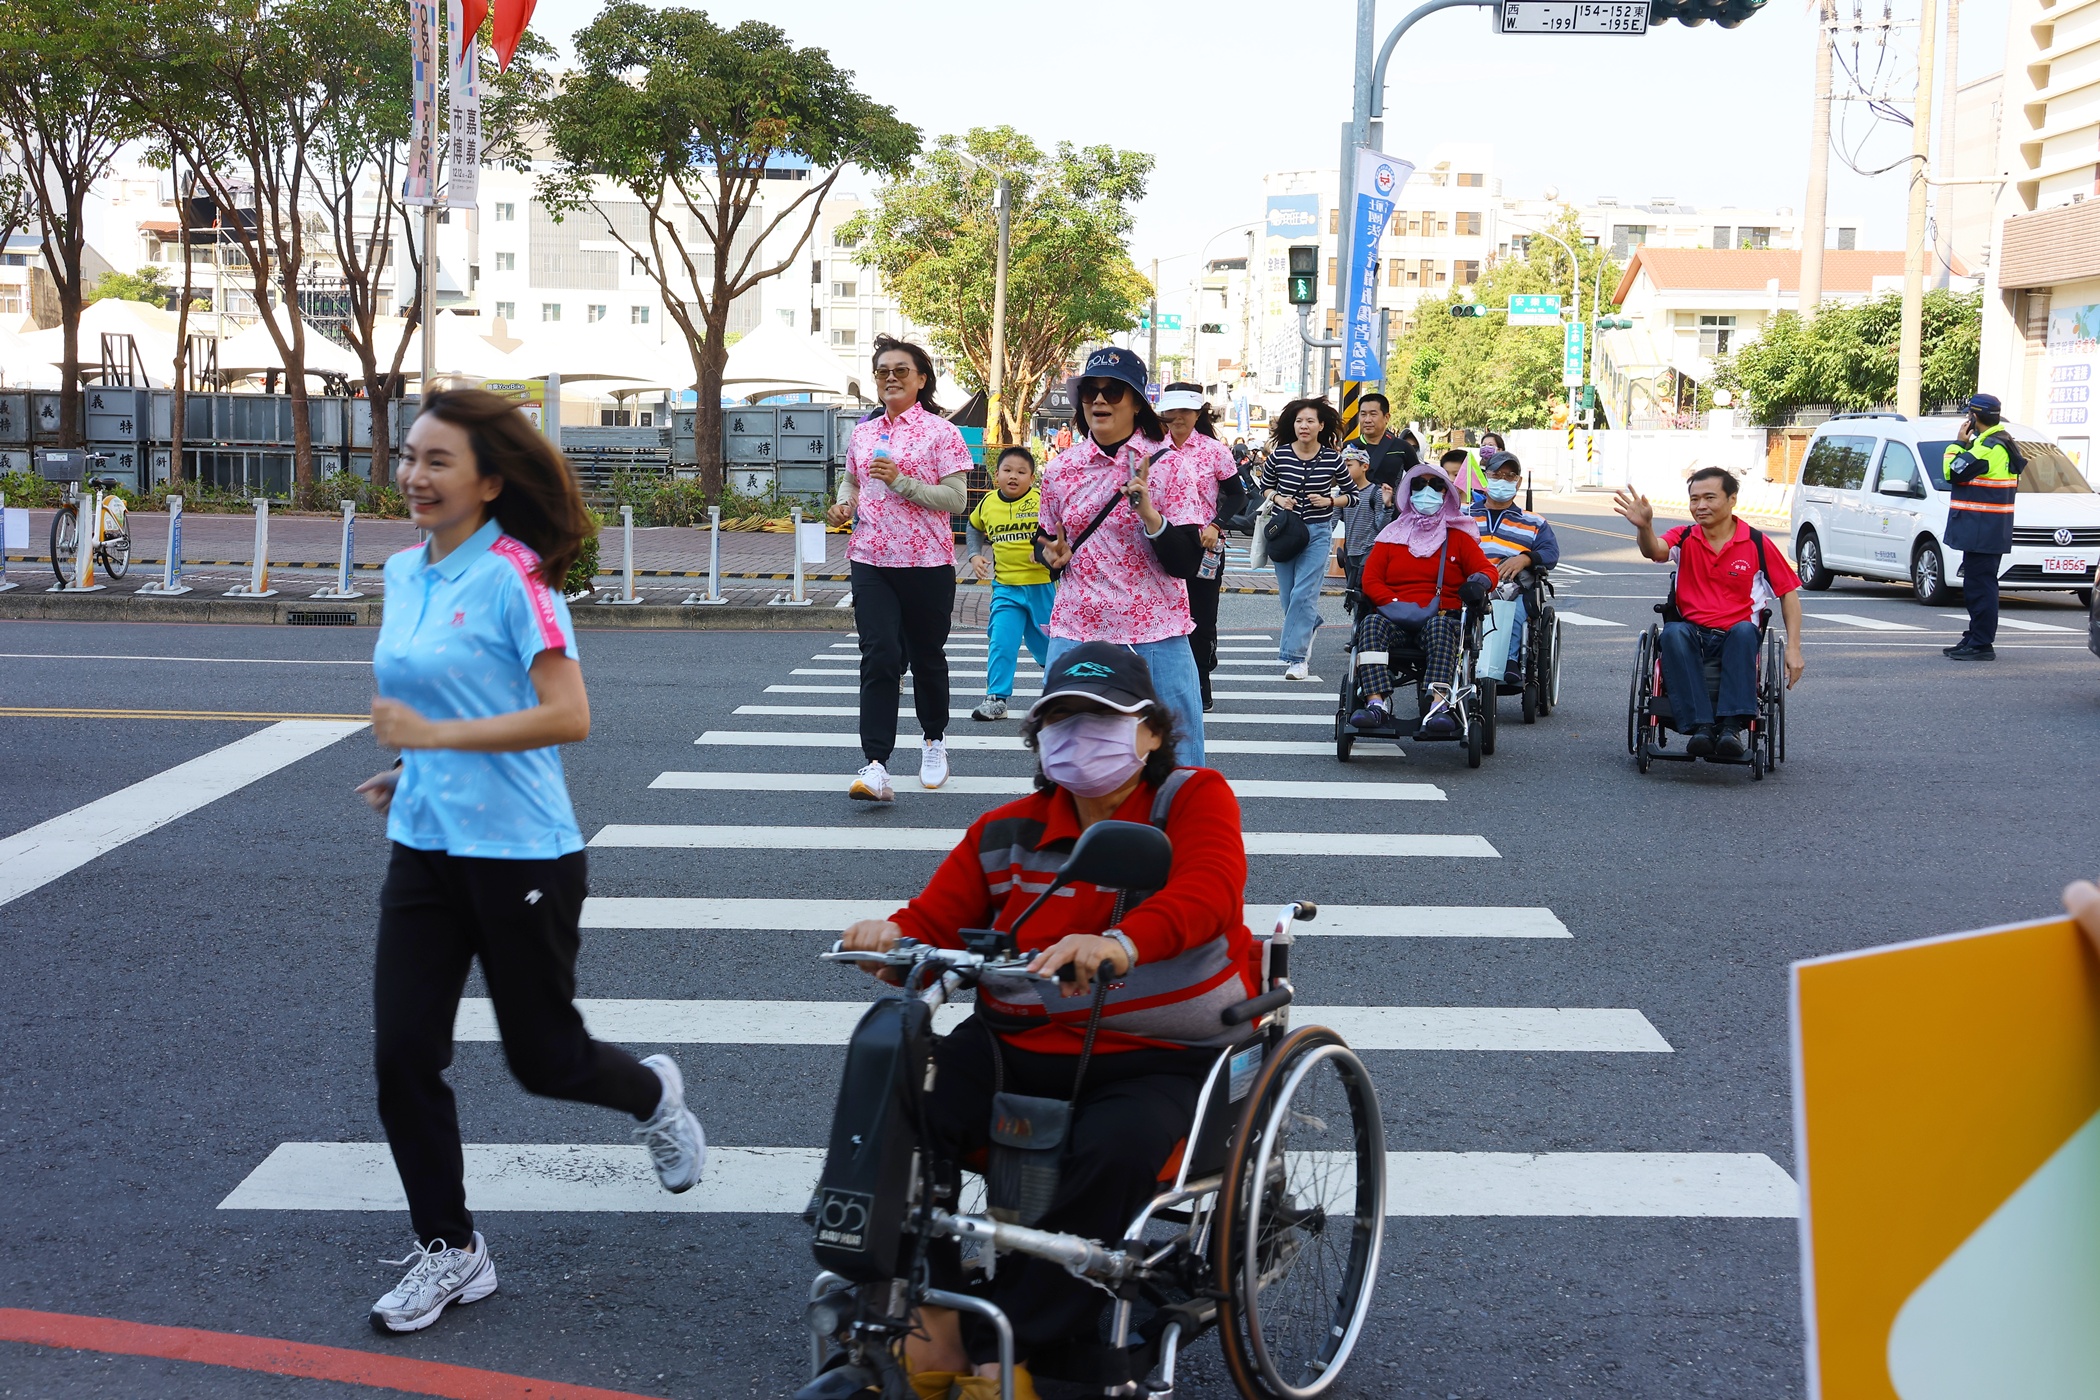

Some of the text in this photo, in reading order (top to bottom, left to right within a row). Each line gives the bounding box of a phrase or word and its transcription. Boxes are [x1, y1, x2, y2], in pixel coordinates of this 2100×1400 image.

[1508, 4, 1519, 15] 西
[1507, 18, 1571, 30] W. -199
[420, 4, 430, 63] EXPO
[452, 105, 463, 165] 市博
[466, 108, 477, 165] 嘉義
[91, 394, 105, 409] 義
[41, 403, 55, 419] 義
[119, 419, 133, 434] 特
[733, 417, 745, 432] 義
[782, 415, 795, 430] 義
[757, 442, 771, 456] 特
[809, 439, 824, 454] 特
[119, 453, 133, 468] 特
[994, 521, 1039, 533] GIANT
